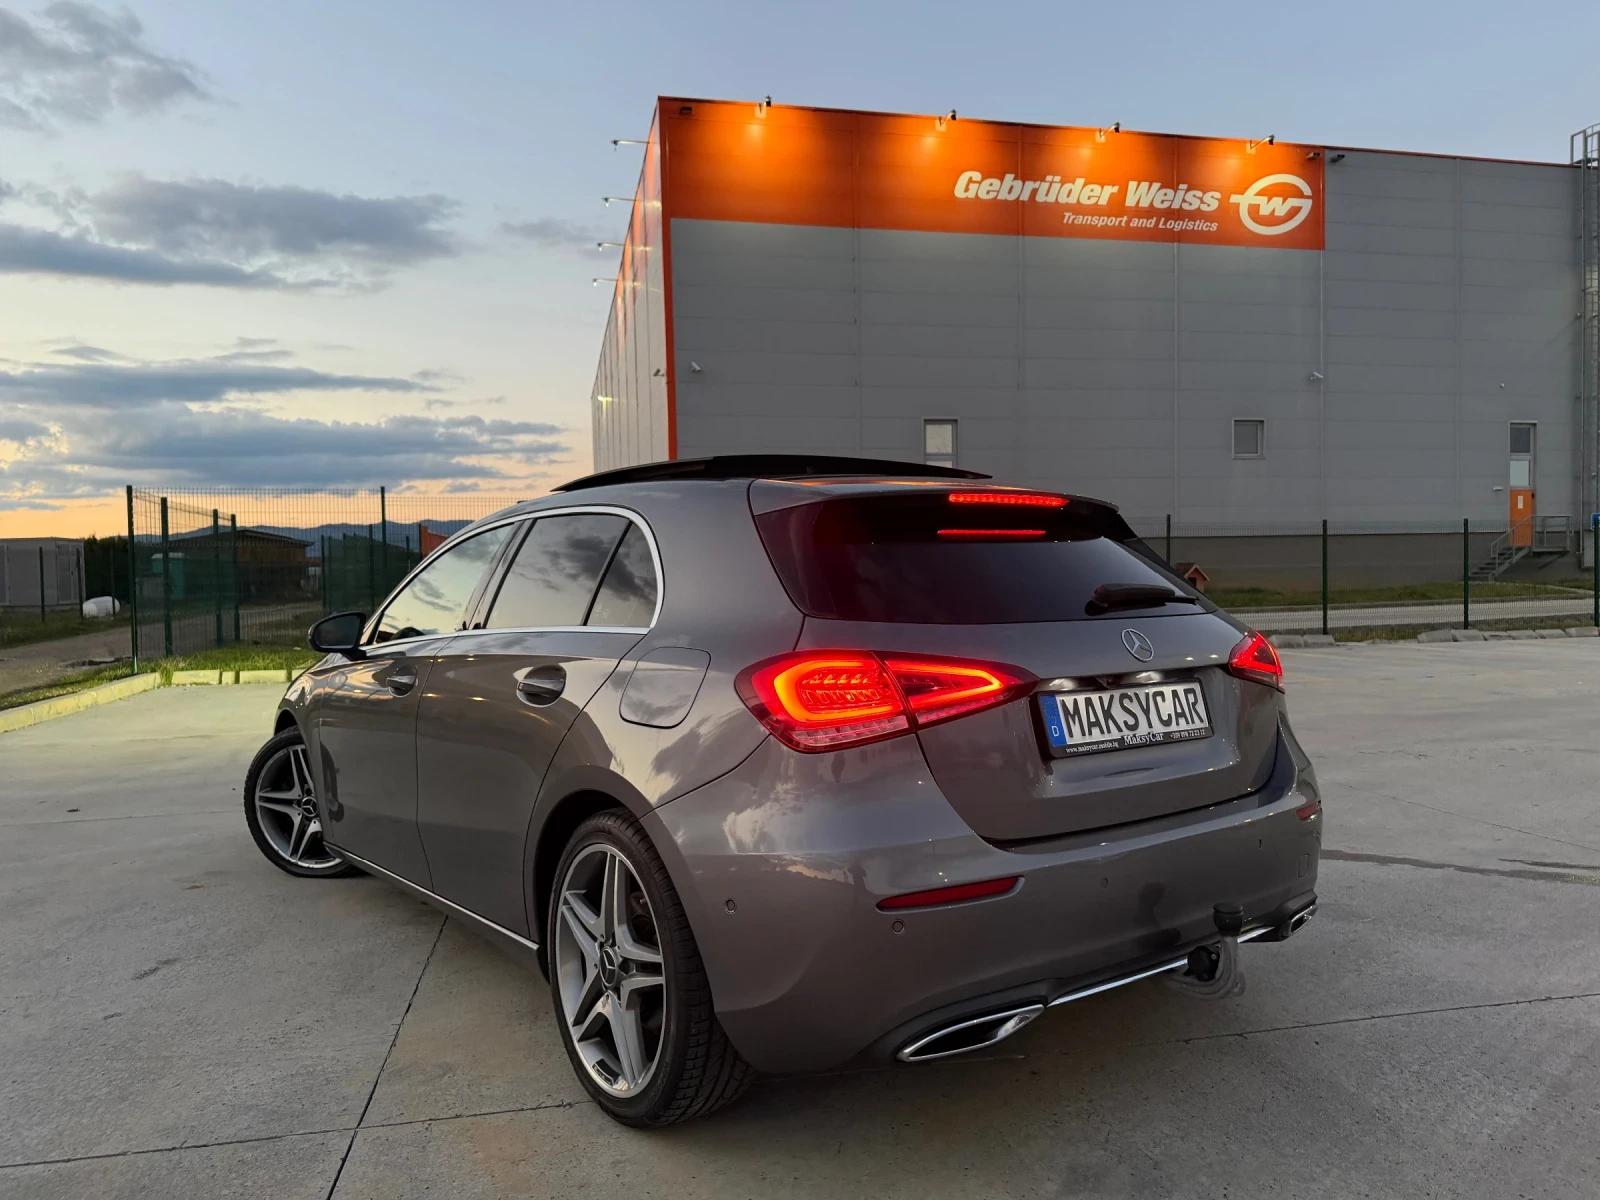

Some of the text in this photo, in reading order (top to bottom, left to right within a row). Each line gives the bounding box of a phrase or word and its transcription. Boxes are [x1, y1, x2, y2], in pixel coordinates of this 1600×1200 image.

[954, 171, 1222, 212] Gebrüder Weiss
[1063, 212, 1219, 232] Transport and Logistics
[1051, 688, 1204, 738] D MAKSYCAR
[1123, 732, 1164, 746] MaksyCar
